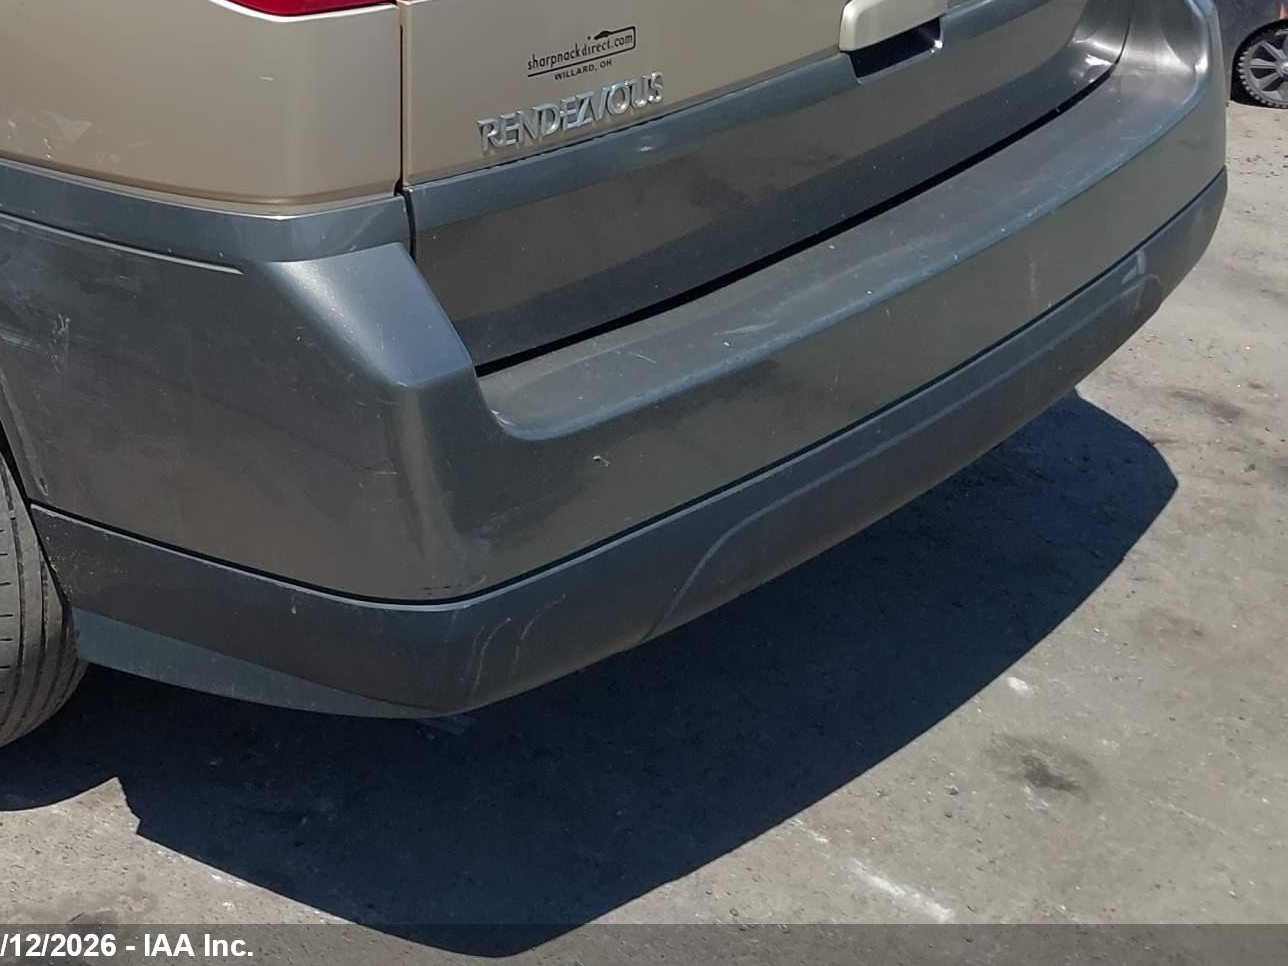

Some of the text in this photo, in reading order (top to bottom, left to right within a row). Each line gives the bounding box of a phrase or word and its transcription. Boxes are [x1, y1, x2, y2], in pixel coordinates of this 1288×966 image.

[527, 34, 634, 71] sharpnackdirect.com
[553, 58, 613, 81] WILLARD, OH
[477, 70, 664, 154] RENDEZVOUS
